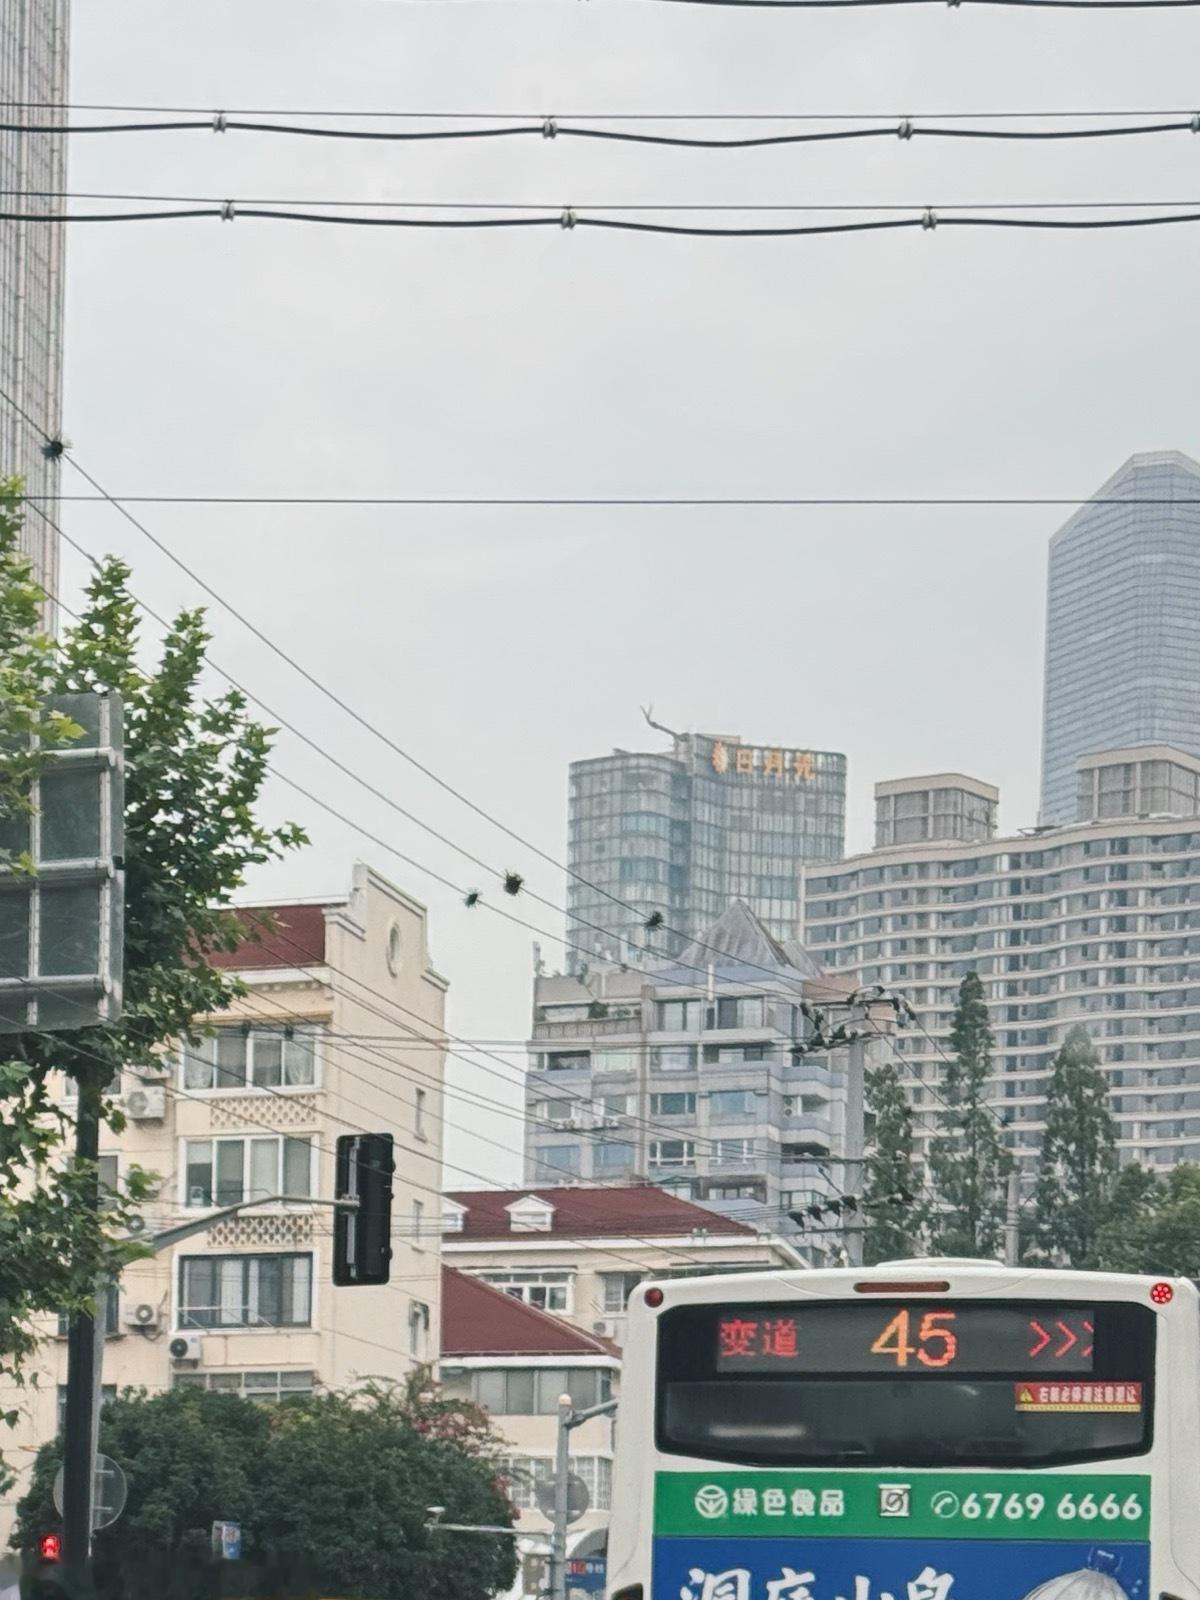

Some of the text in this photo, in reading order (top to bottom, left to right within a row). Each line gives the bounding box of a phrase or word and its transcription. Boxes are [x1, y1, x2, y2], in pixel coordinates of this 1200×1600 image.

[735, 747, 817, 781] 日月光
[719, 1318, 800, 1358] 变道
[870, 1309, 957, 1367] 45
[961, 1492, 1143, 1521] 6769 6666
